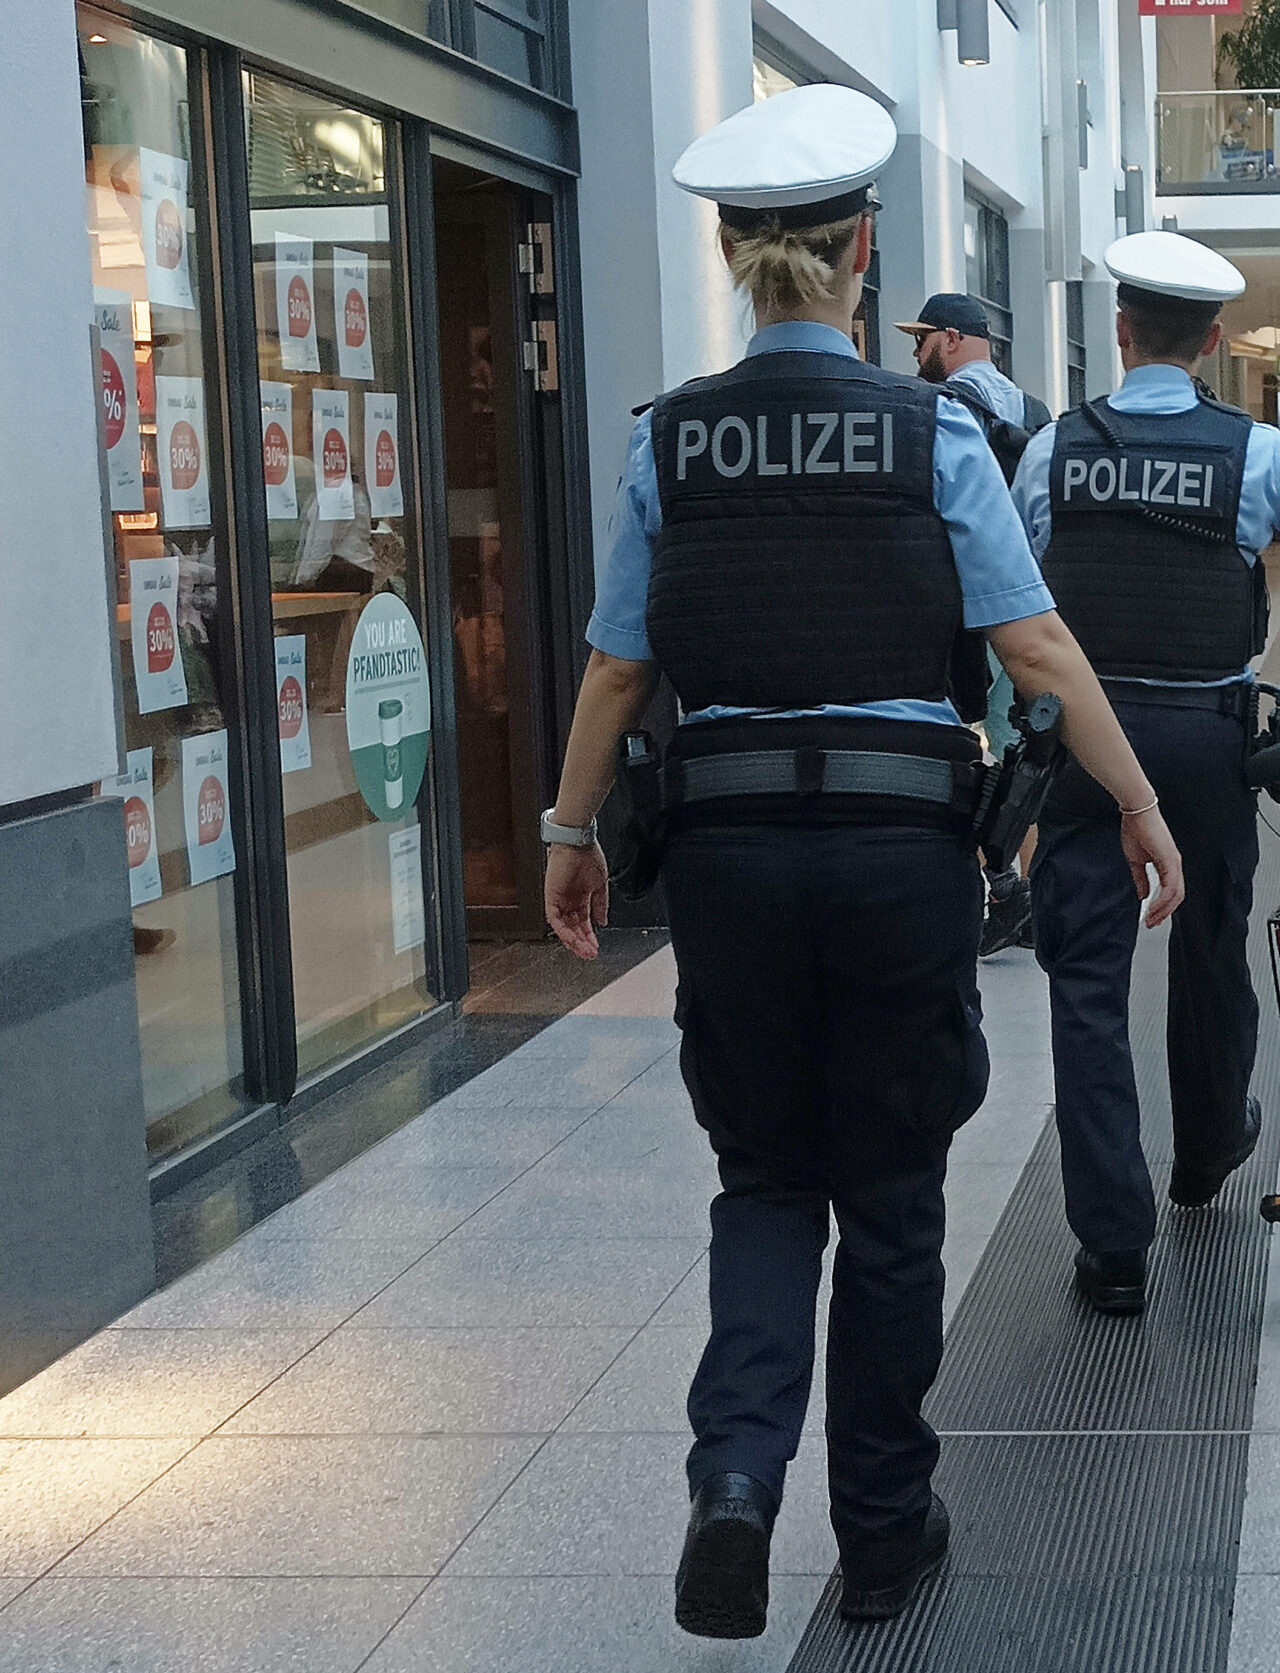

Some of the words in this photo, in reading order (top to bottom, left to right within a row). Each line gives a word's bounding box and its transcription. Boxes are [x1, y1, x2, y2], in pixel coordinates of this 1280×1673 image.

[101, 310, 121, 332] Sale
[677, 412, 894, 481] POLIZEI
[1064, 457, 1214, 508] POLIZEI
[364, 621, 386, 649] YOU
[388, 618, 408, 645] ARE
[352, 646, 421, 683] PFANDTASTIC!
[127, 823, 150, 849] 0%
